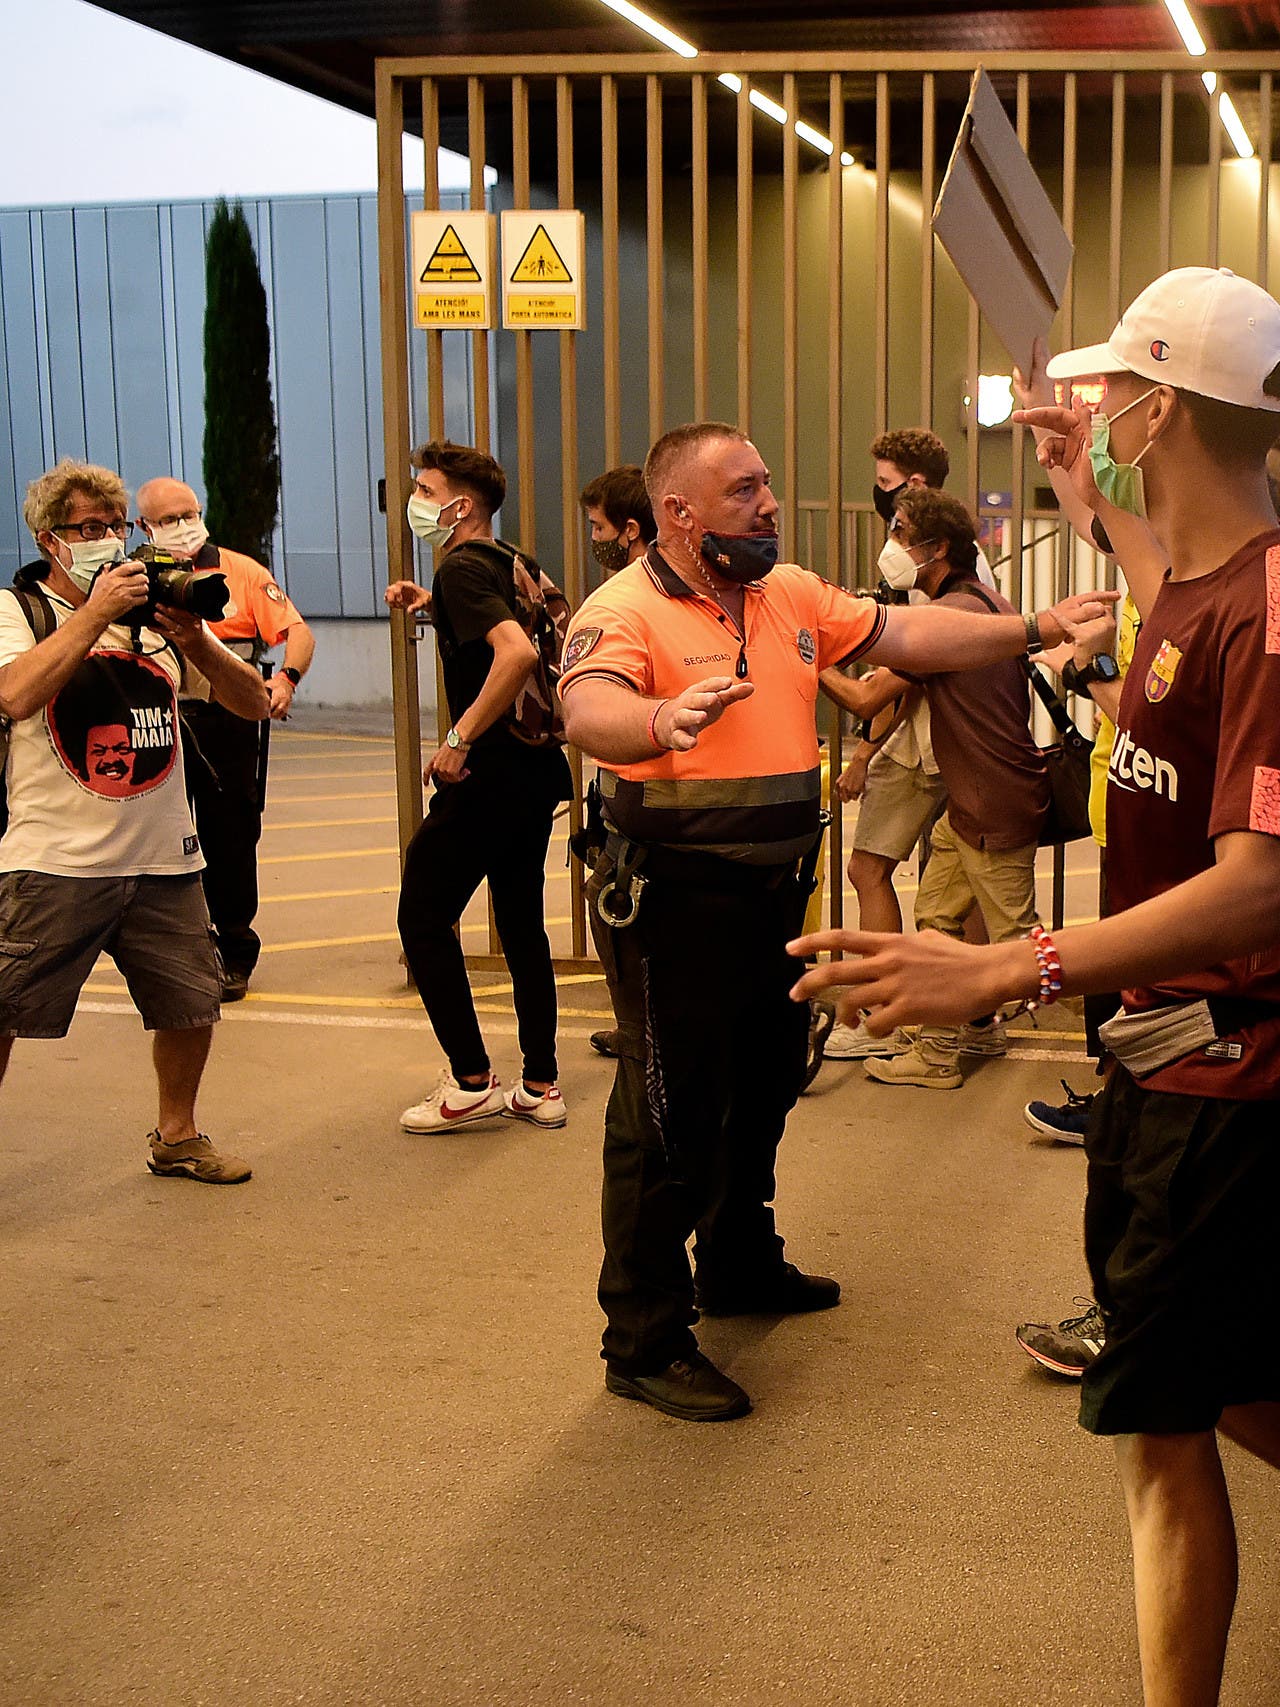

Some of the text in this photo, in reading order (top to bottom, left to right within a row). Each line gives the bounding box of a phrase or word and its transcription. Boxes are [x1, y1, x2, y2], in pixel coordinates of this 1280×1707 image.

[442, 310, 456, 319] LES
[458, 310, 481, 318] MANS
[684, 653, 731, 666] SEGURIDAD
[130, 706, 163, 728] TIM
[132, 726, 174, 749] MAIA
